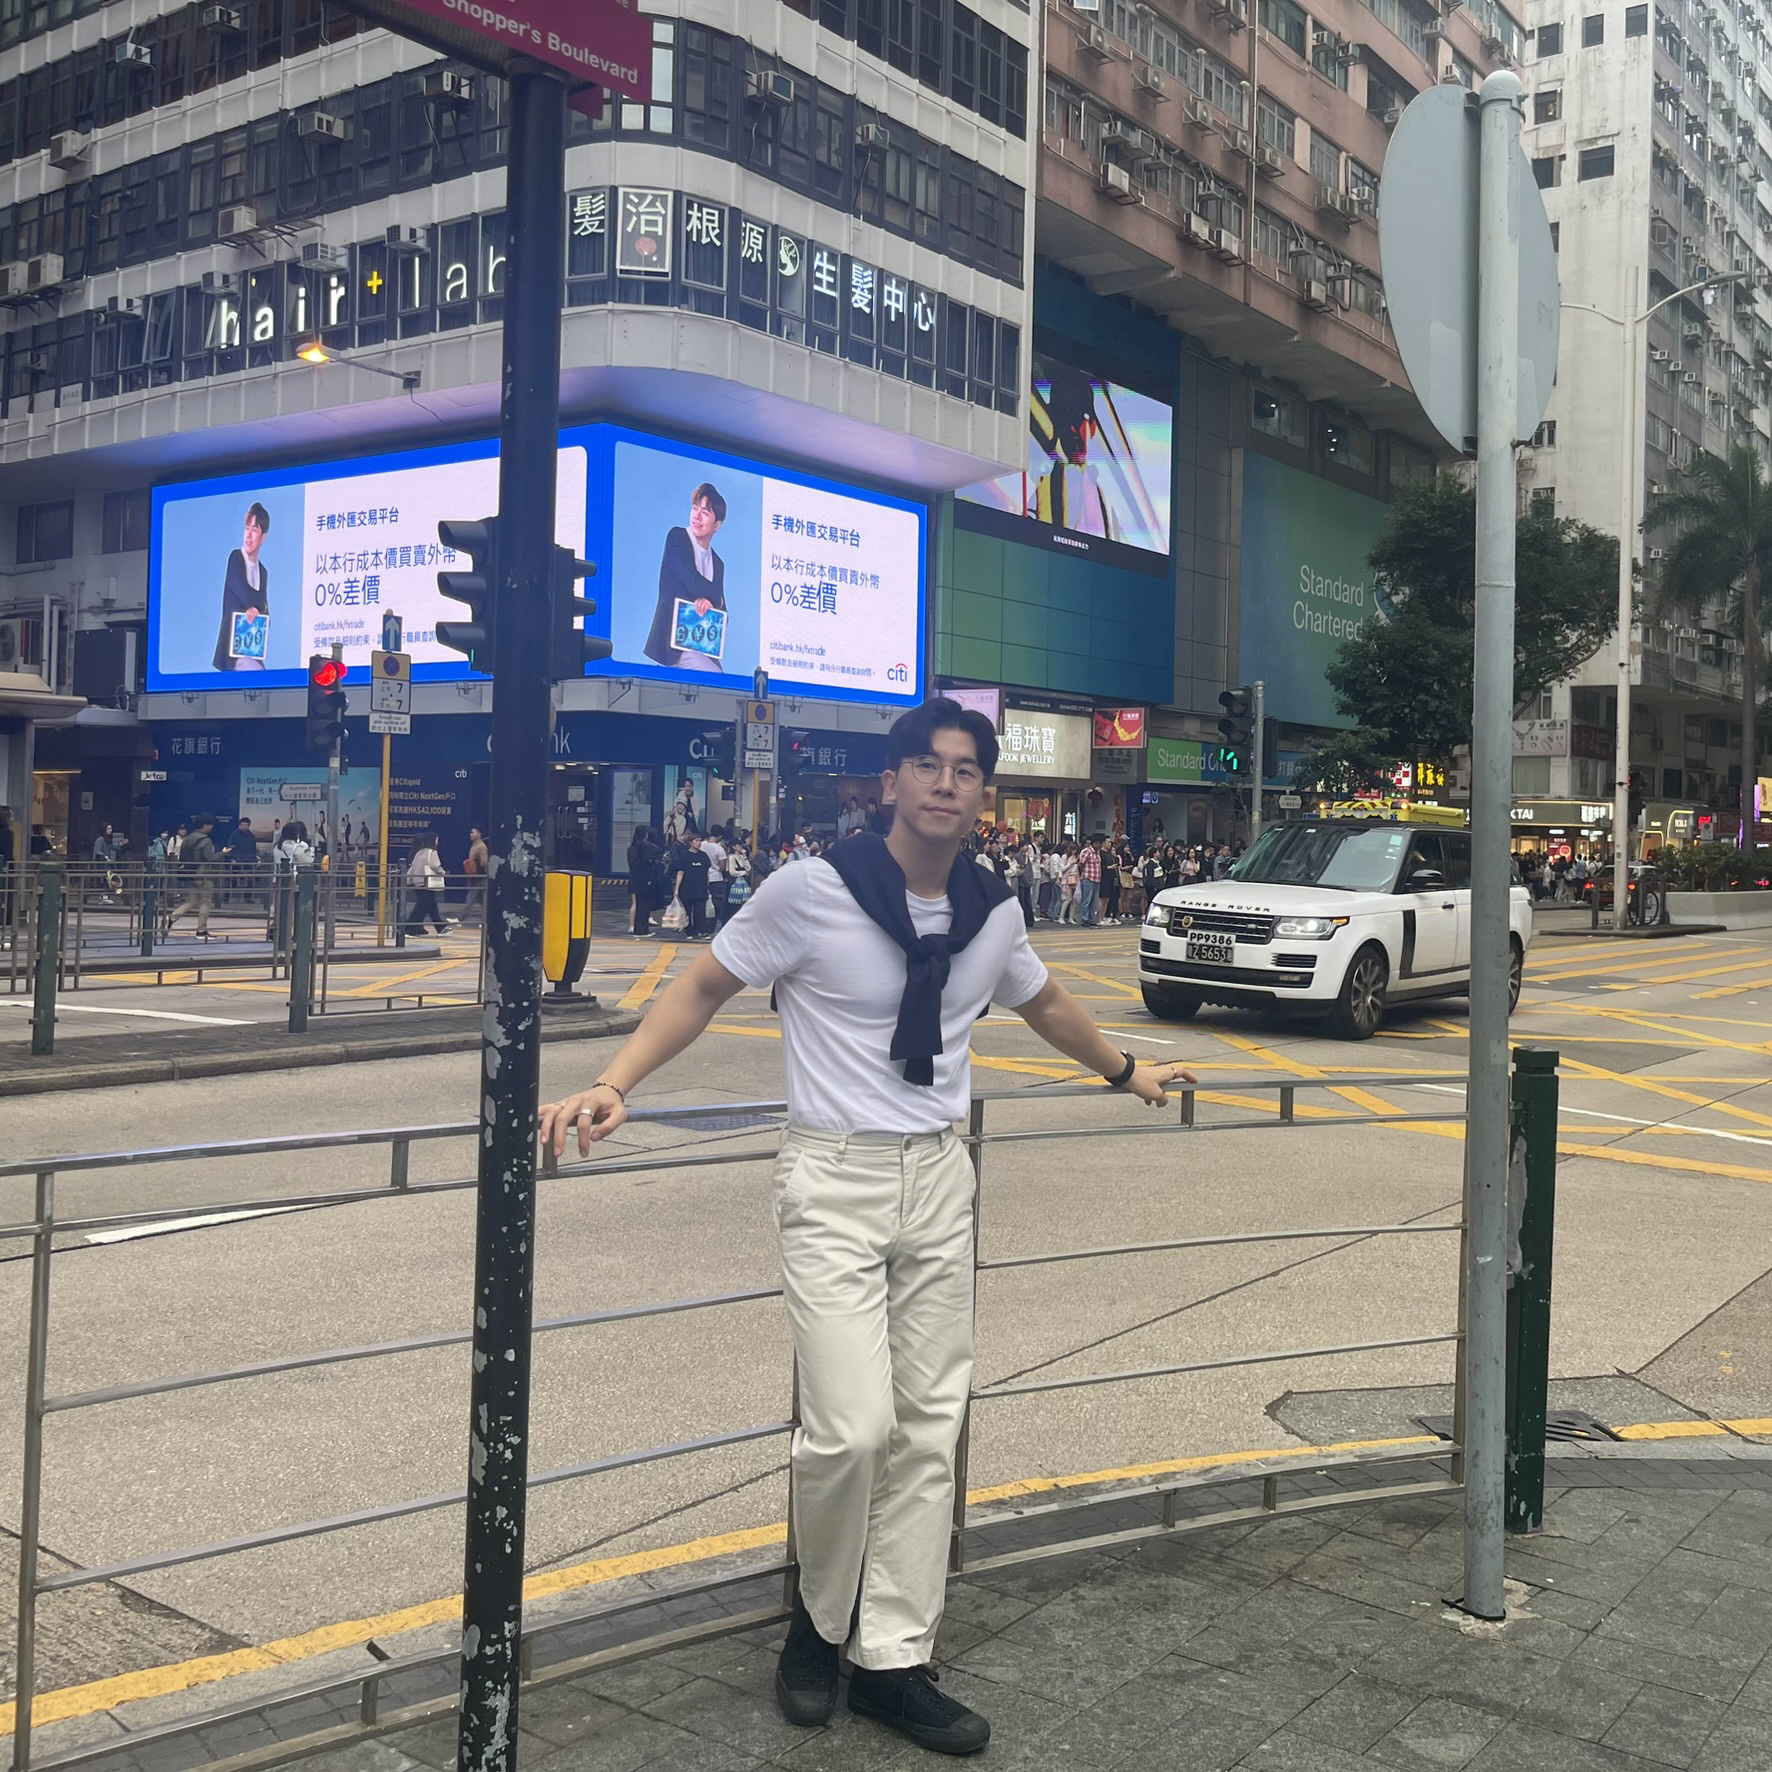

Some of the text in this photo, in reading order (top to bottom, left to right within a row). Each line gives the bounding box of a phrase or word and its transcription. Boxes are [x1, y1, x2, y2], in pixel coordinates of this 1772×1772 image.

[547, 32, 638, 85] Boulevard
[316, 506, 399, 531] 手機外匯交易平台
[771, 514, 861, 548] 手機外匯交易平台
[771, 553, 880, 590] 以本行成本價買賣外幣
[315, 575, 381, 607] 0%差價
[771, 580, 838, 615] 0%差價
[1300, 564, 1364, 607] Standard
[1293, 600, 1364, 642] Chartered
[887, 665, 908, 682] citi
[397, 683, 403, 693] 7
[396, 700, 403, 710] 7
[171, 737, 221, 755] 花旗銀行
[1157, 748, 1206, 770] Standard
[1180, 900, 1271, 913] RANGE ROVER
[1190, 932, 1233, 946] PP9386
